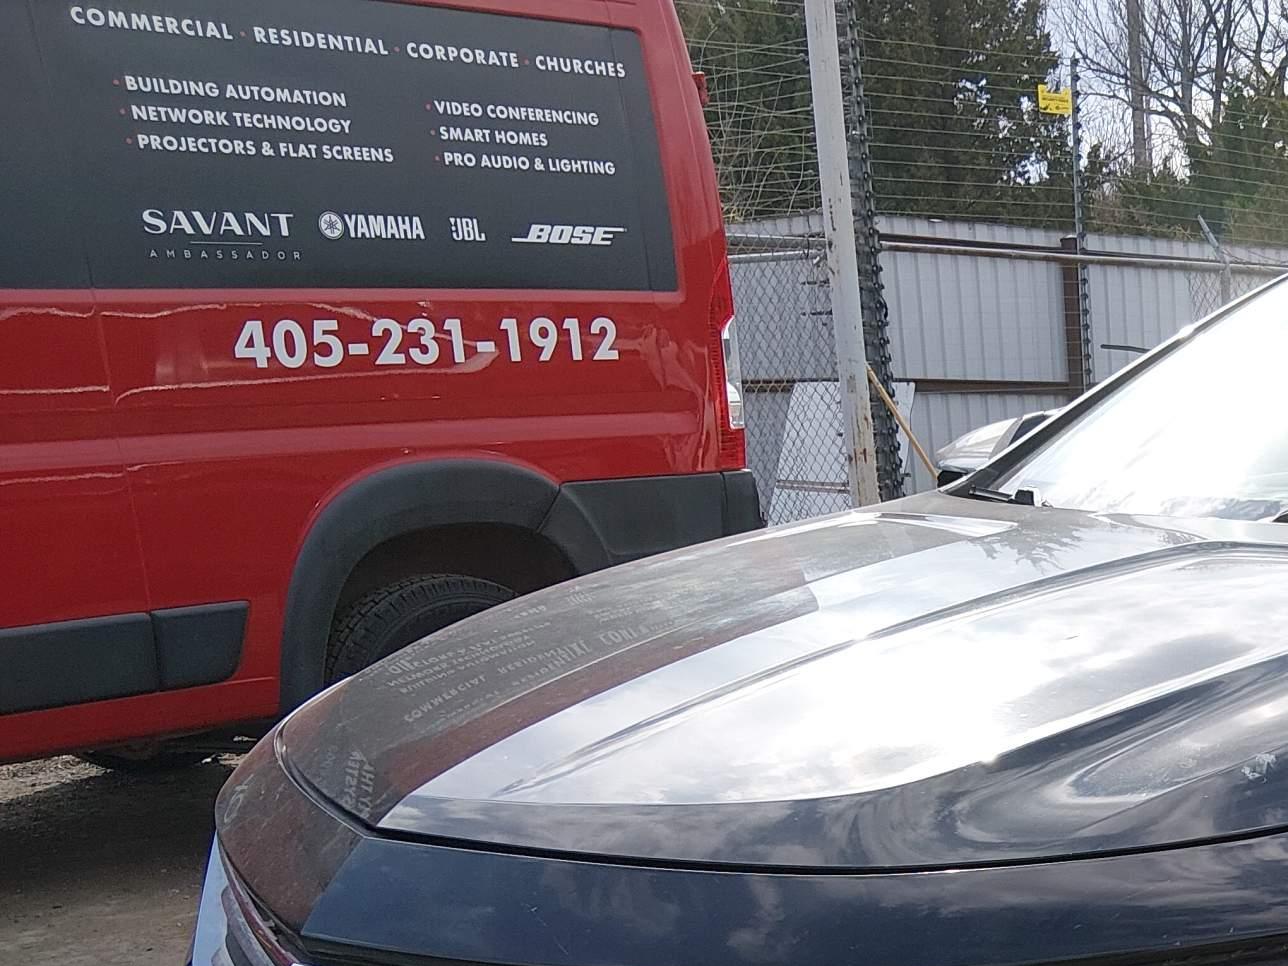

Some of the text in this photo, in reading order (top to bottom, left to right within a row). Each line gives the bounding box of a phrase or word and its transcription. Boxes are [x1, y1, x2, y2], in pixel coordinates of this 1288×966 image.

[69, 5, 626, 78] COMMERCIAL RESIDENTIAL CORPORATE CHURCHES
[123, 74, 347, 108] BUILDING AUTOMATION
[130, 104, 352, 134] NETWORK TECHNOLOGY
[433, 99, 600, 126] VIDEO CONFERENCING
[136, 133, 394, 163] PROJECTORS & FLAT SCREENS
[439, 125, 549, 147] SMART HOMES
[443, 151, 616, 176] PRO AUDIO & LIGHTING
[142, 208, 294, 238] SAVANT
[343, 213, 426, 240] YAMAHA
[449, 217, 487, 242] JBL
[511, 223, 628, 246] BOSE
[149, 249, 302, 261] AMBASSADOR
[233, 317, 621, 369] 405-231-1912
